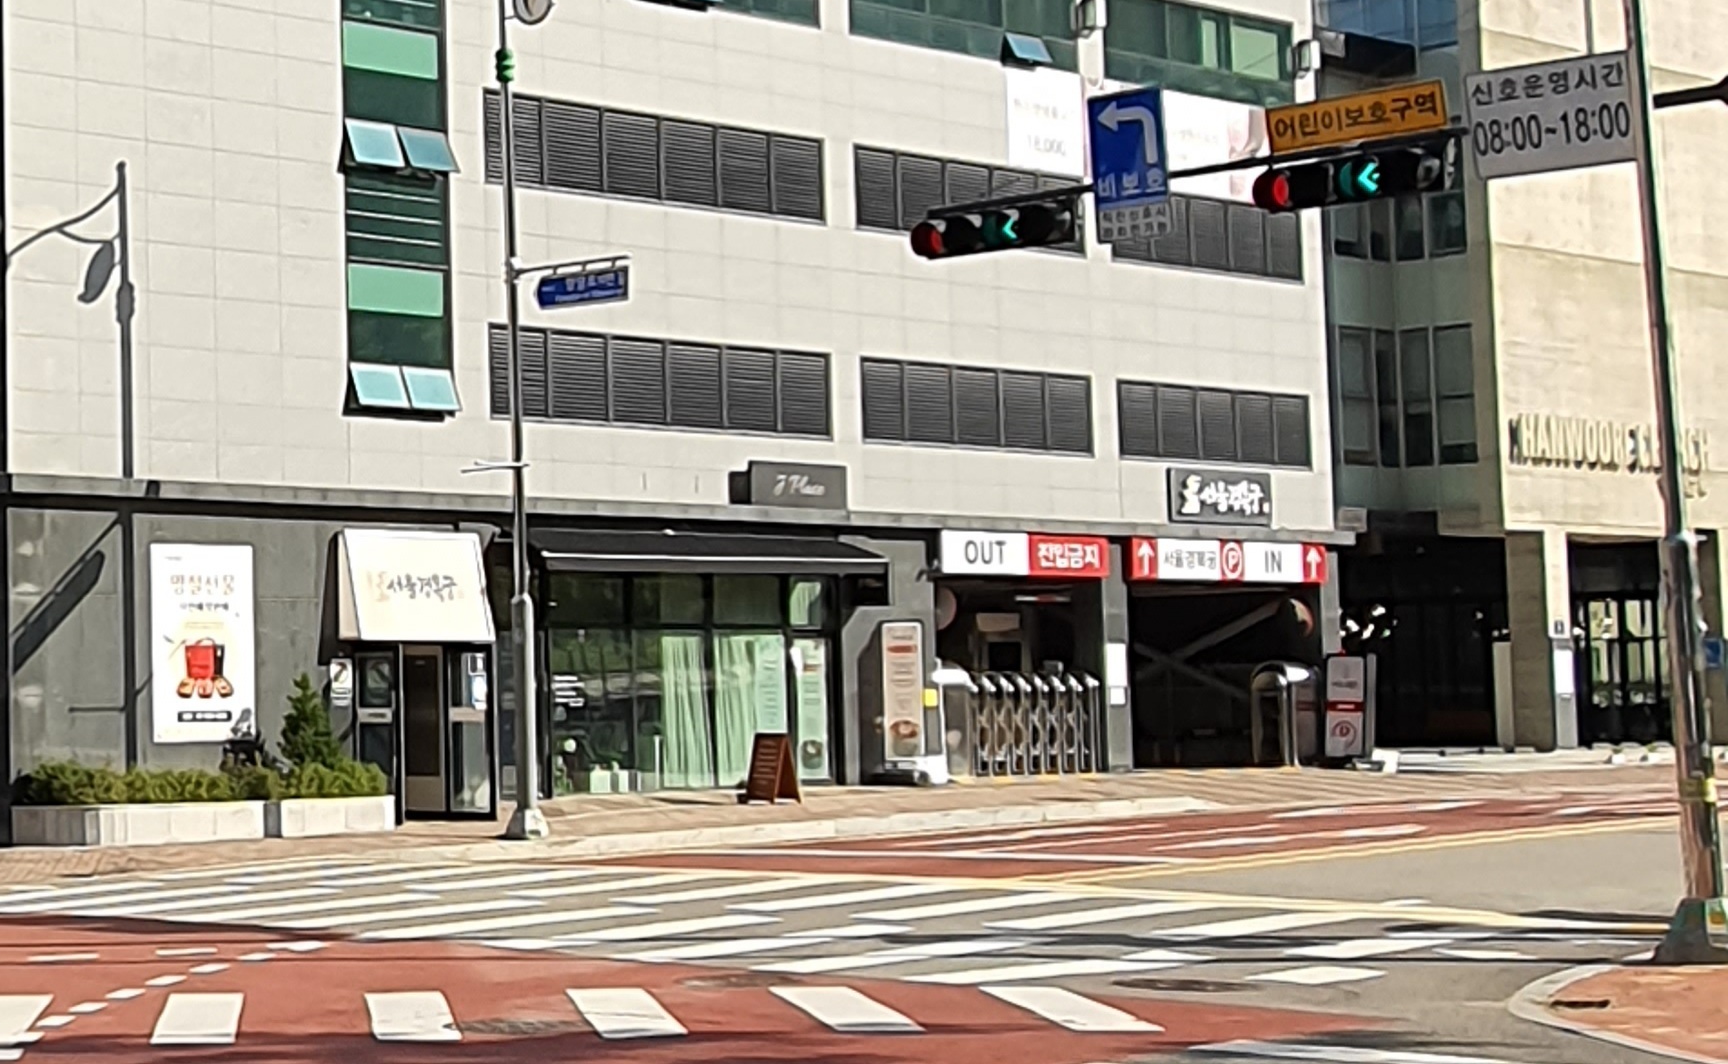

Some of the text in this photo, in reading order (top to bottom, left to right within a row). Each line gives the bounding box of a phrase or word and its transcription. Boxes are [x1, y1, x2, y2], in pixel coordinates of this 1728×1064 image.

[1471, 62, 1624, 106] 신호운영시간
[1273, 90, 1440, 139] 어린이보호구역
[1473, 100, 1631, 157] 08:00~18:00
[1097, 167, 1167, 198] 비보호
[964, 539, 1007, 566] OUT
[1036, 542, 1101, 569] 진입금지
[1163, 548, 1217, 570] 서울경복궁
[1264, 550, 1283, 574] IN
